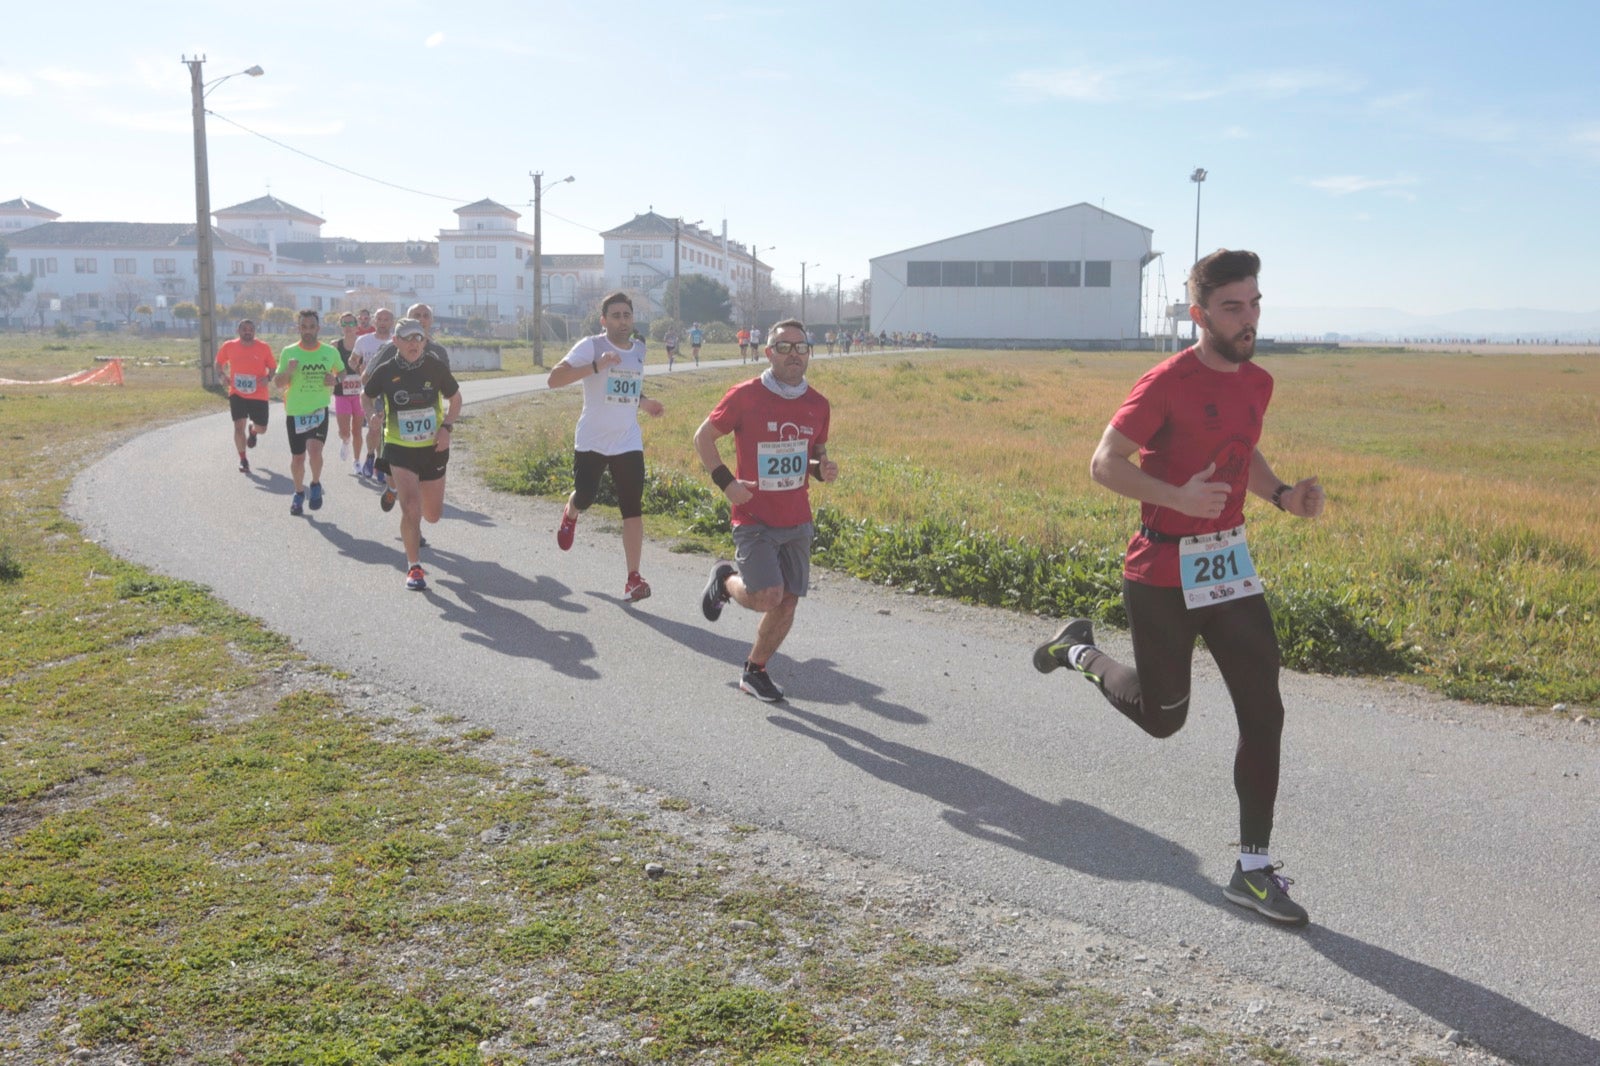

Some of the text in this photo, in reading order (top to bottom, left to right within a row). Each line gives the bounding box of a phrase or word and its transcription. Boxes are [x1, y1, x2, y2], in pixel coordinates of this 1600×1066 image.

[613, 380, 636, 394] 301
[405, 418, 431, 432] 970
[767, 455, 802, 475] 280
[1193, 550, 1239, 583] 281
